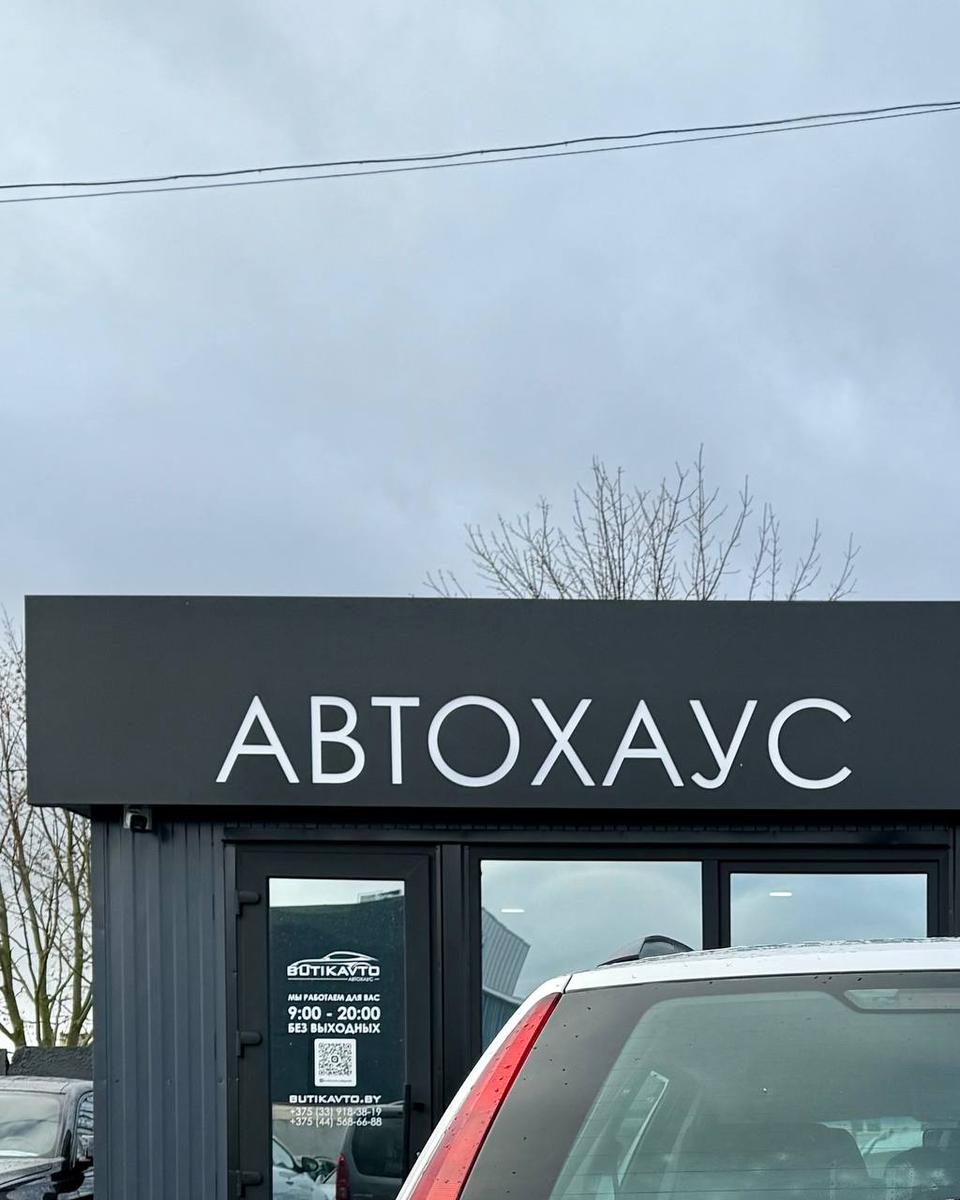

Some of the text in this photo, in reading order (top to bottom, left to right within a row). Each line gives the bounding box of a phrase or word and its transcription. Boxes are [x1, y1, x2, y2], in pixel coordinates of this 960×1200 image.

[216, 695, 852, 789] АВТОХАУС
[287, 966, 380, 977] BUTIKAVTO
[287, 993, 381, 1002] МЫ РАБОТАЕМ ДЛЯ ВАС
[287, 1006, 322, 1021] 9:00
[337, 1006, 381, 1021] 20:00
[287, 1022, 381, 1035] БЕЗ ВЫХОДНЫХ
[289, 1094, 382, 1104] BUTIKAVTO.BY
[290, 1106, 313, 1117] +375
[315, 1106, 334, 1118] (33)
[290, 1116, 383, 1128] +375 (44) 568-66-88
